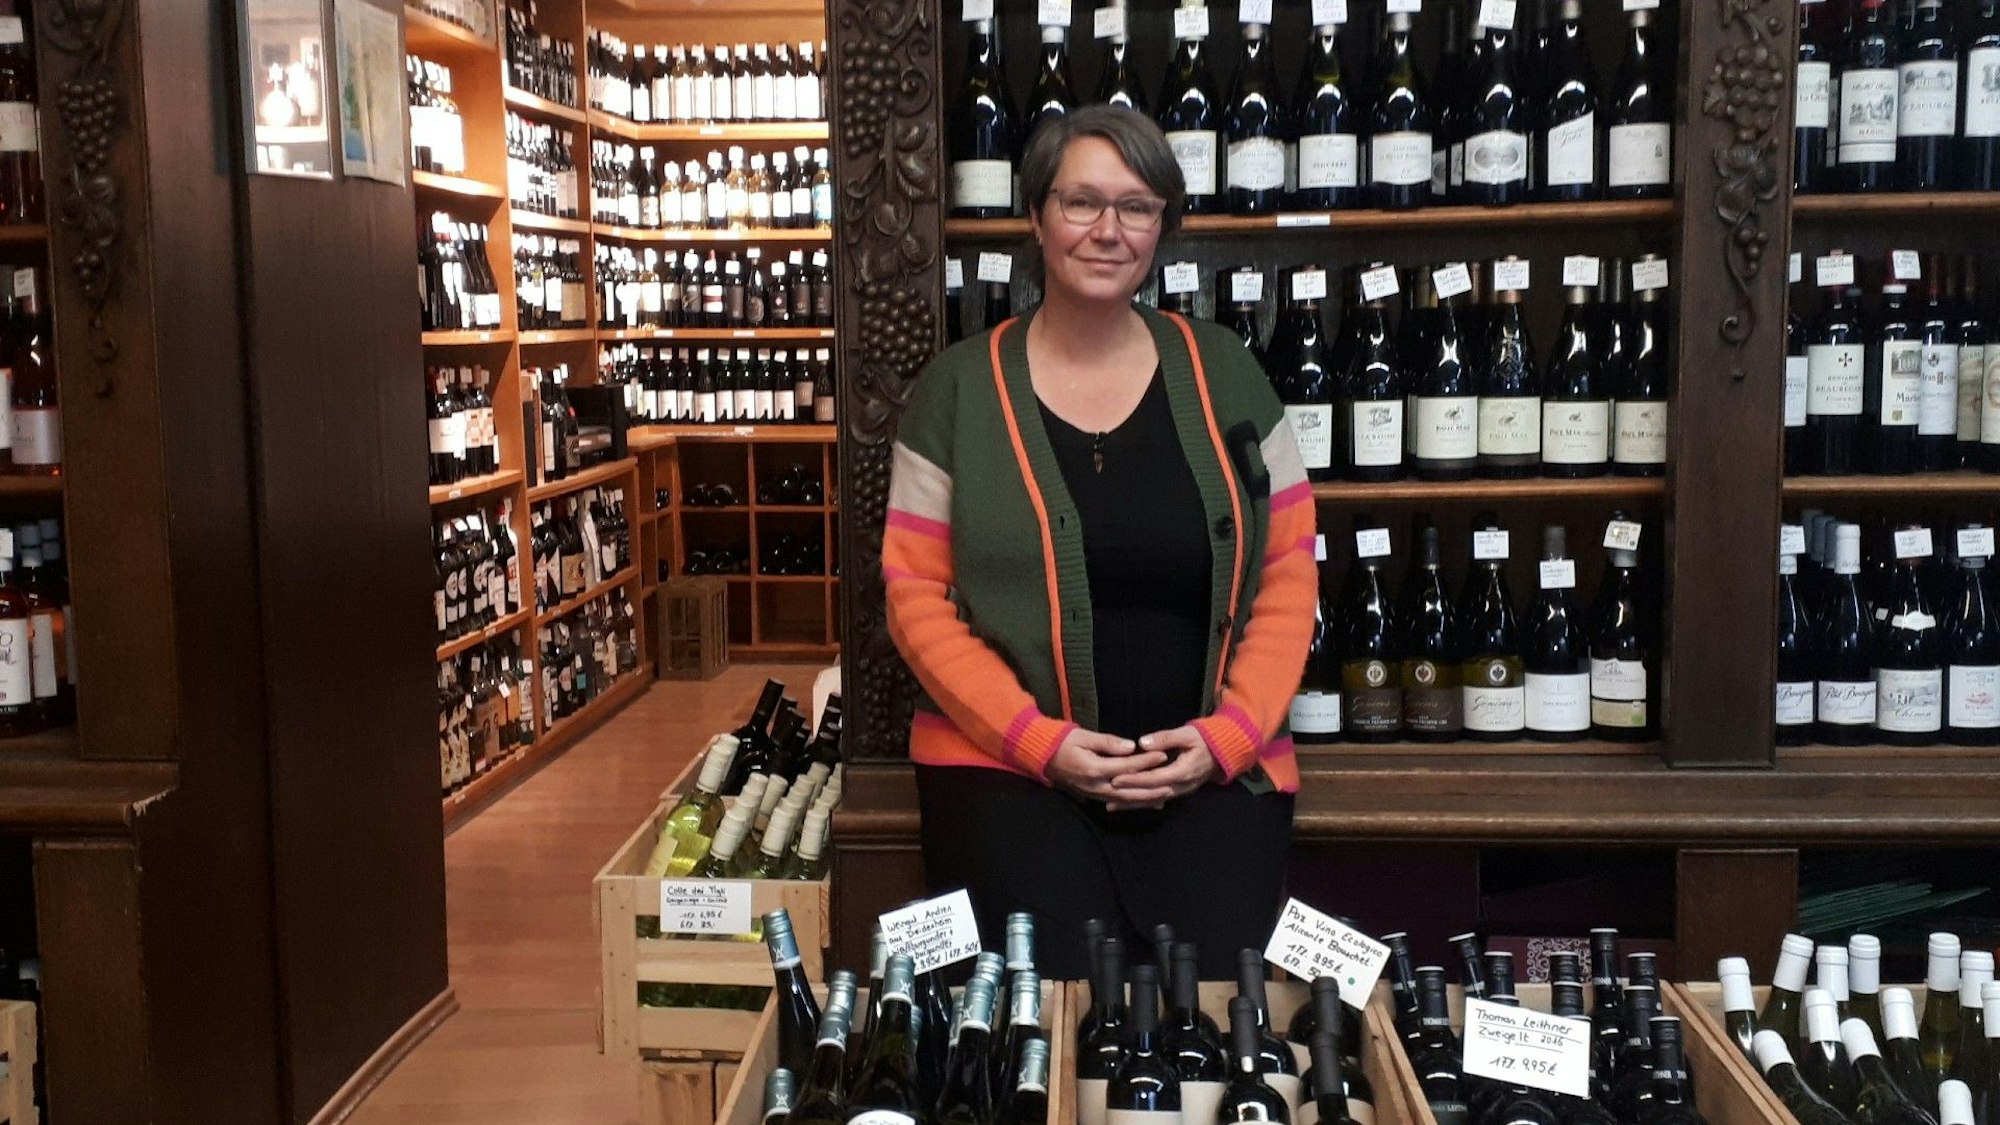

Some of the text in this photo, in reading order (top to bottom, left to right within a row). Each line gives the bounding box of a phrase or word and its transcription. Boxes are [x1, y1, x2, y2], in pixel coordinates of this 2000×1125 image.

[1315, 919, 1336, 937] Vino
[1341, 932, 1384, 958] Ecologico
[1478, 1025, 1530, 1045] Zweigelt
[1523, 1016, 1573, 1035] Leithner
